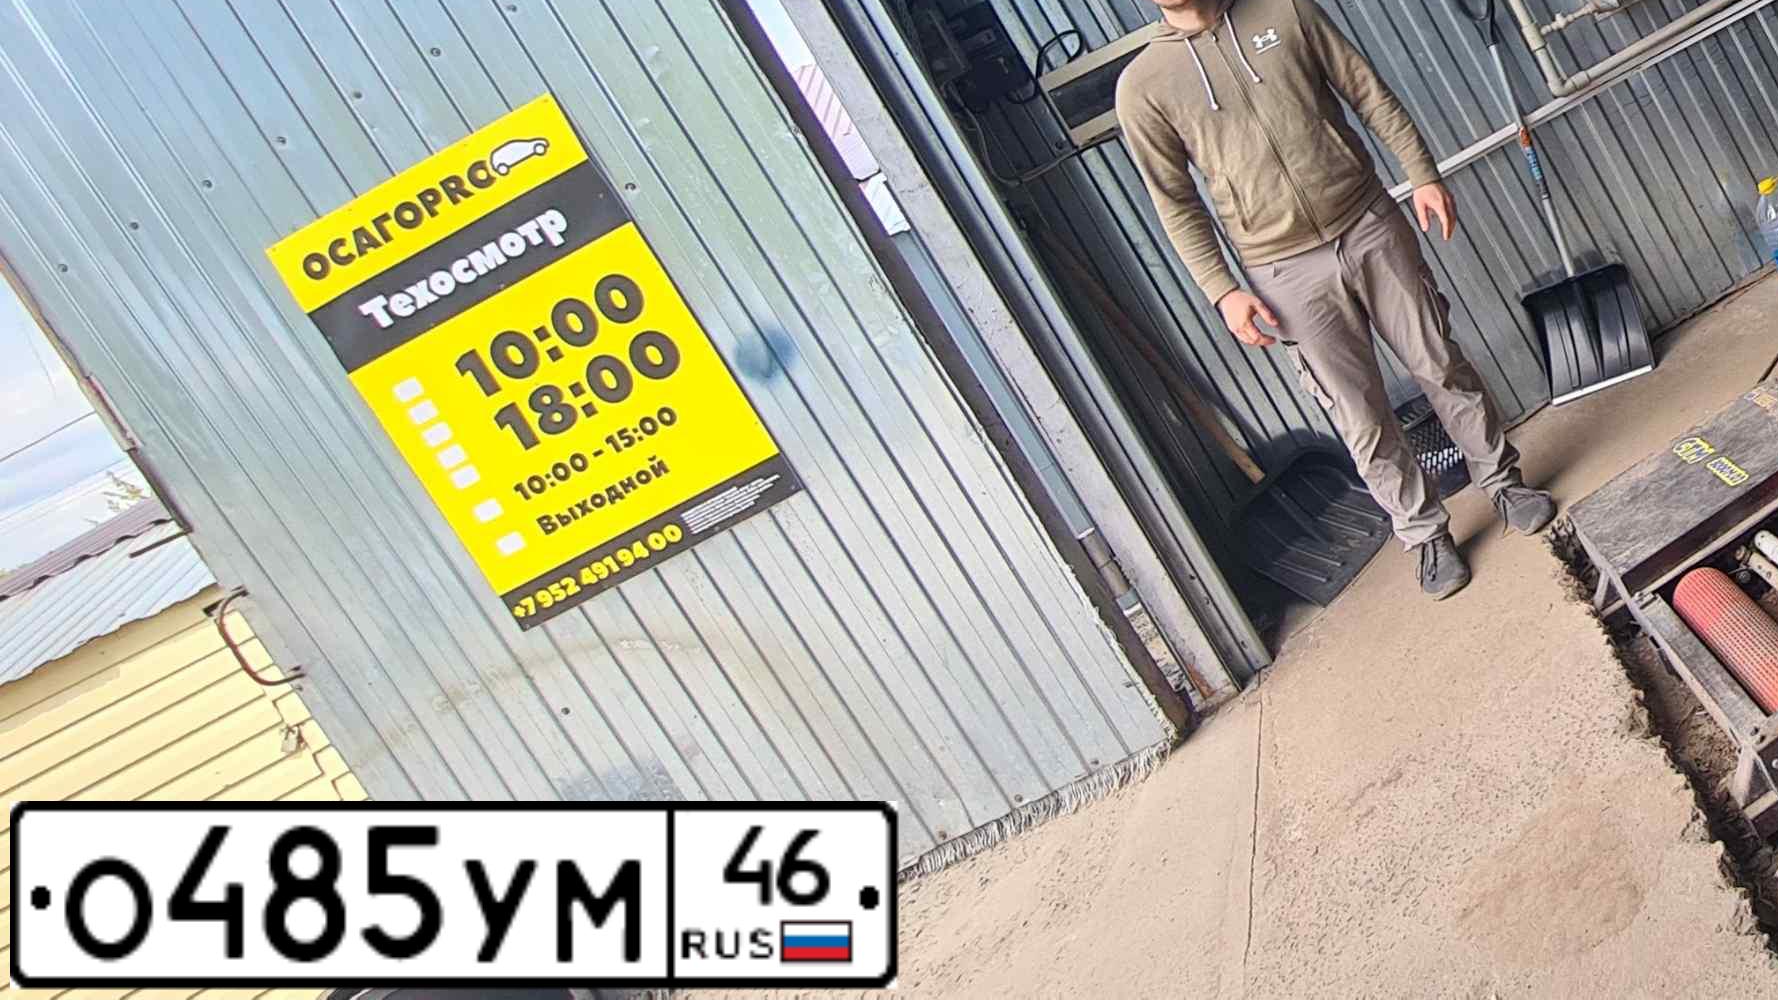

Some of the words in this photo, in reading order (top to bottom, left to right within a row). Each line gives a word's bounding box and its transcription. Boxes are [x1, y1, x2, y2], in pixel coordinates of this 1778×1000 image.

[358, 209, 568, 329] Техосмотр
[455, 273, 645, 397] 10:00
[494, 330, 681, 451] 18:00
[513, 452, 589, 501] 10:00
[605, 406, 678, 453] 15:00
[536, 455, 671, 536] Выходной
